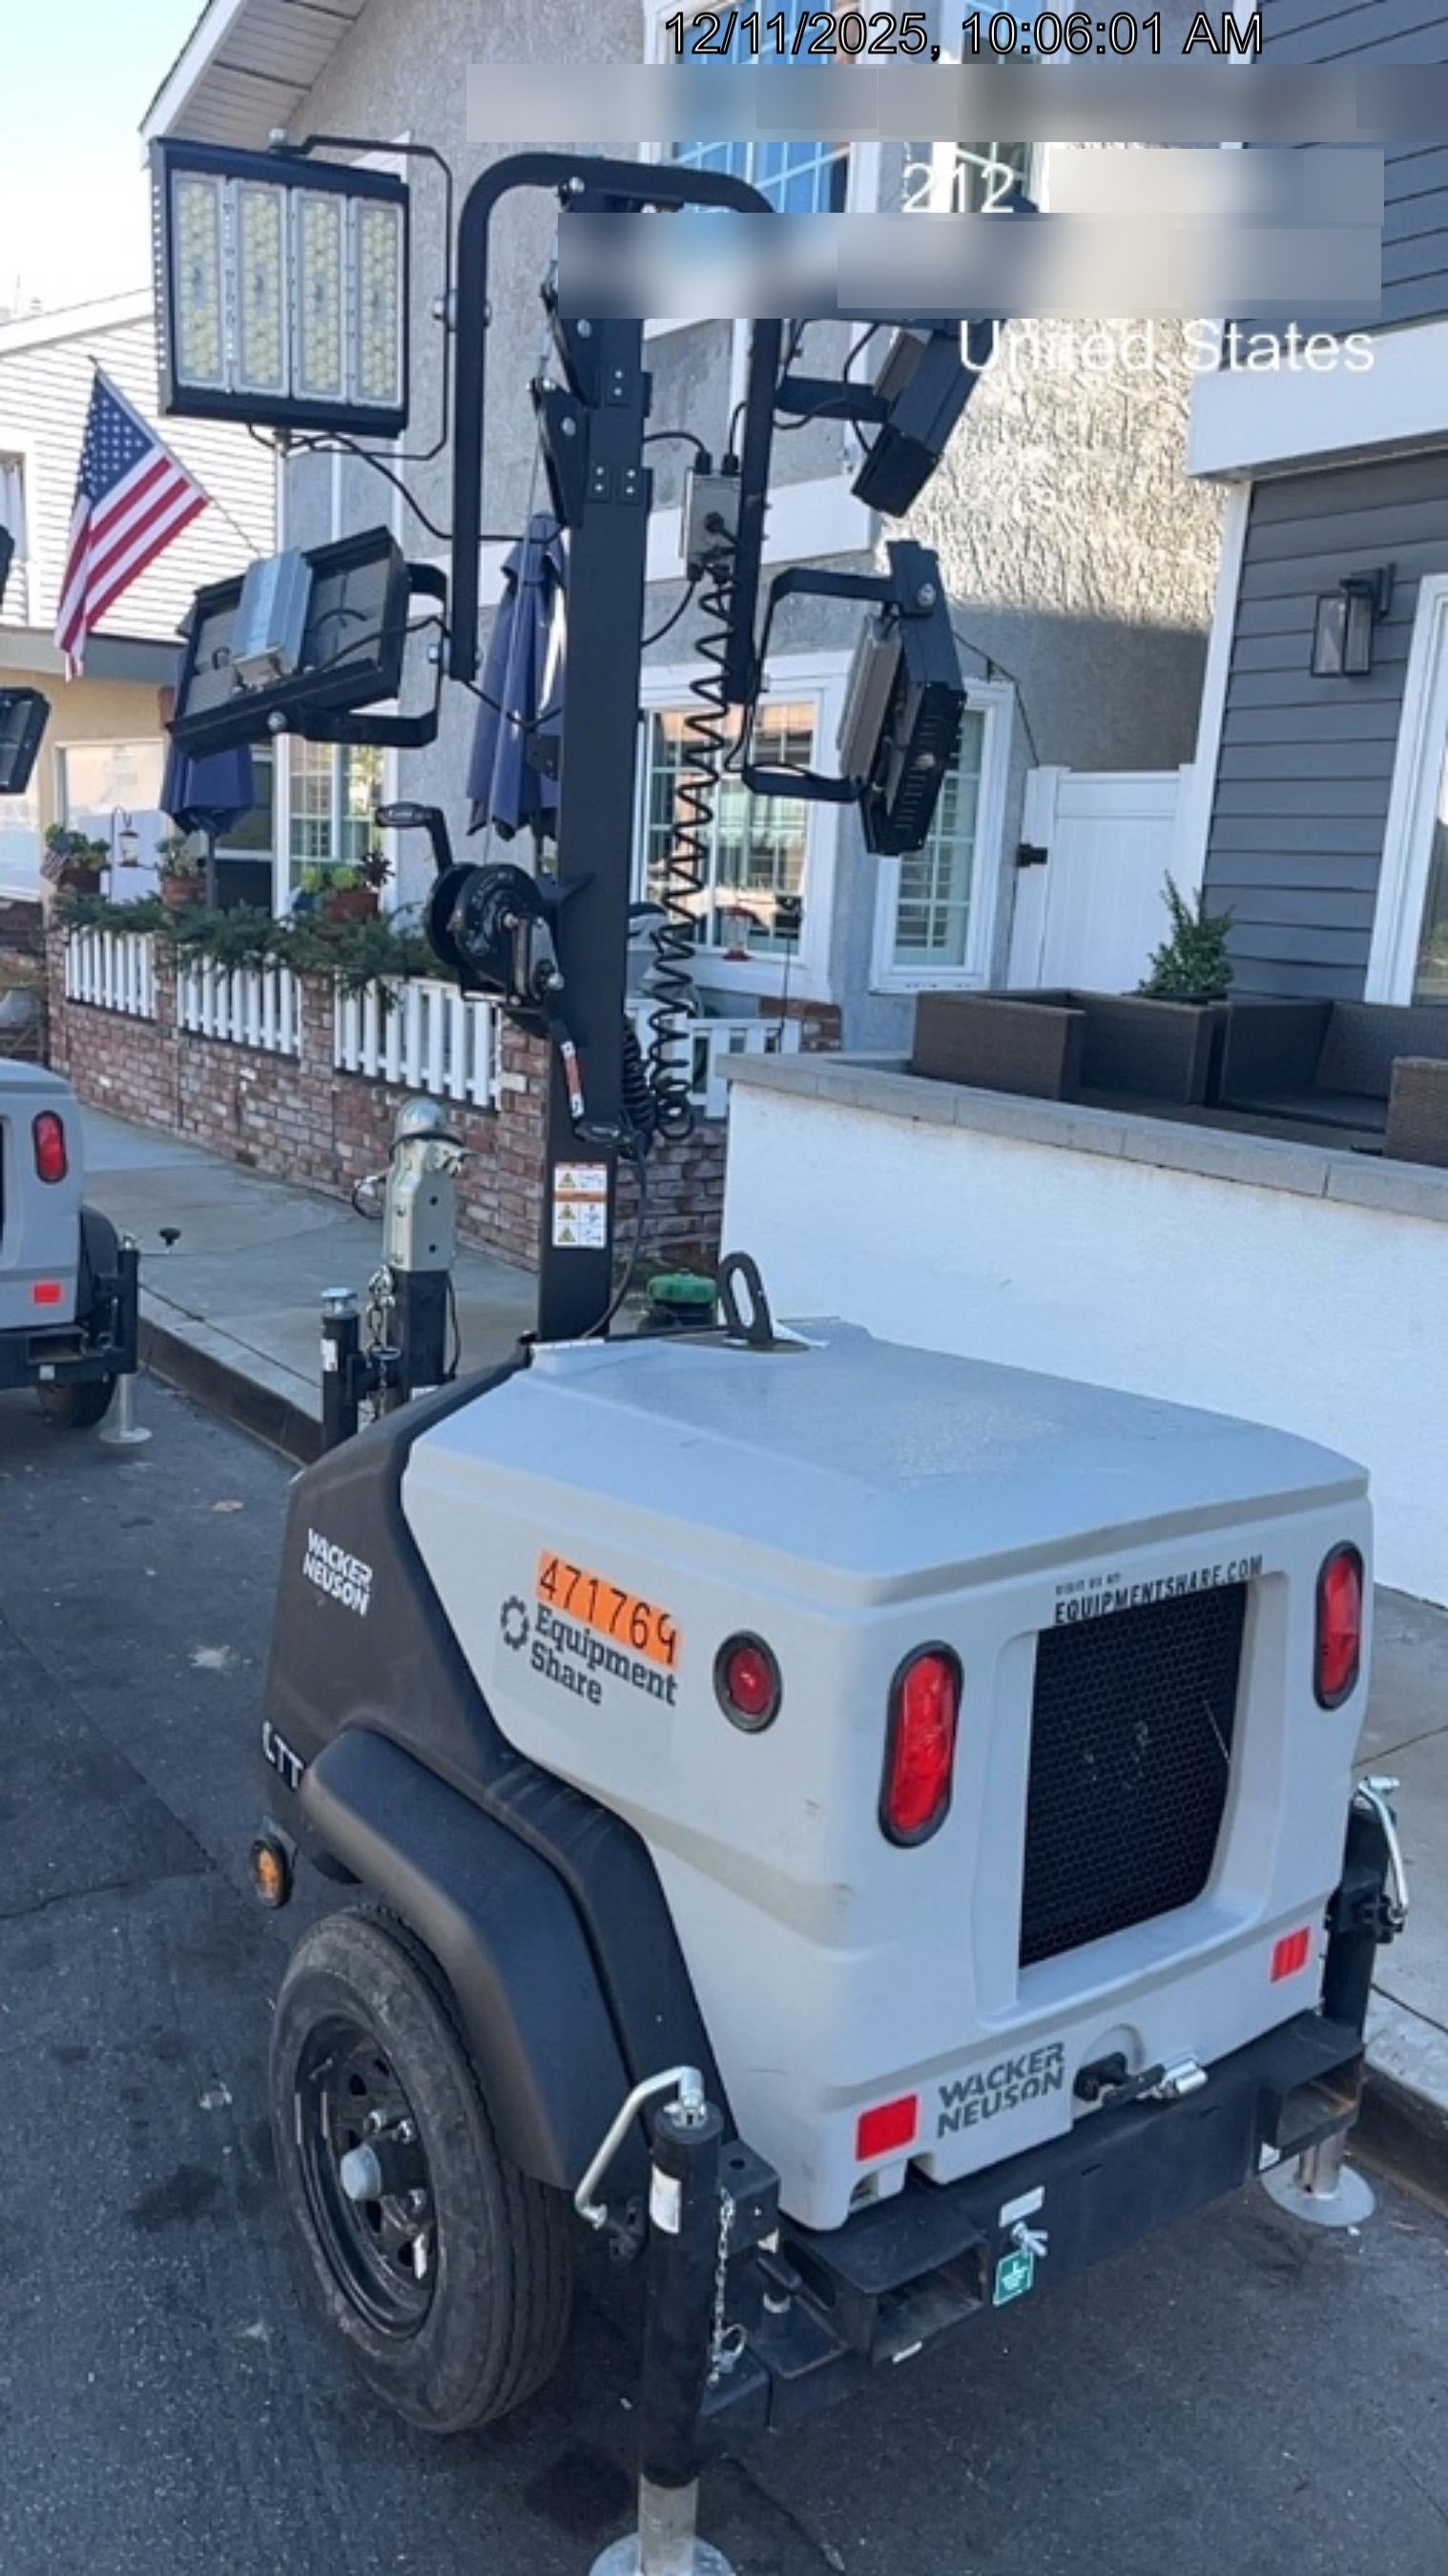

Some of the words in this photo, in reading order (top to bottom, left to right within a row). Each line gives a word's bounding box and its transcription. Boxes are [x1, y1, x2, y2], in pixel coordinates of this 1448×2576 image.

[303, 1551, 370, 1616] NEUSON
[307, 1527, 373, 1586] WACKER
[1054, 1554, 1264, 1624] EQUIPMENTSHARE.COM
[540, 1557, 676, 1667] 471769
[530, 1639, 603, 1706] Share
[535, 1602, 678, 1707] Equipment
[937, 2066, 1064, 2138] NEUSON
[939, 2041, 1065, 2109] WACKER
